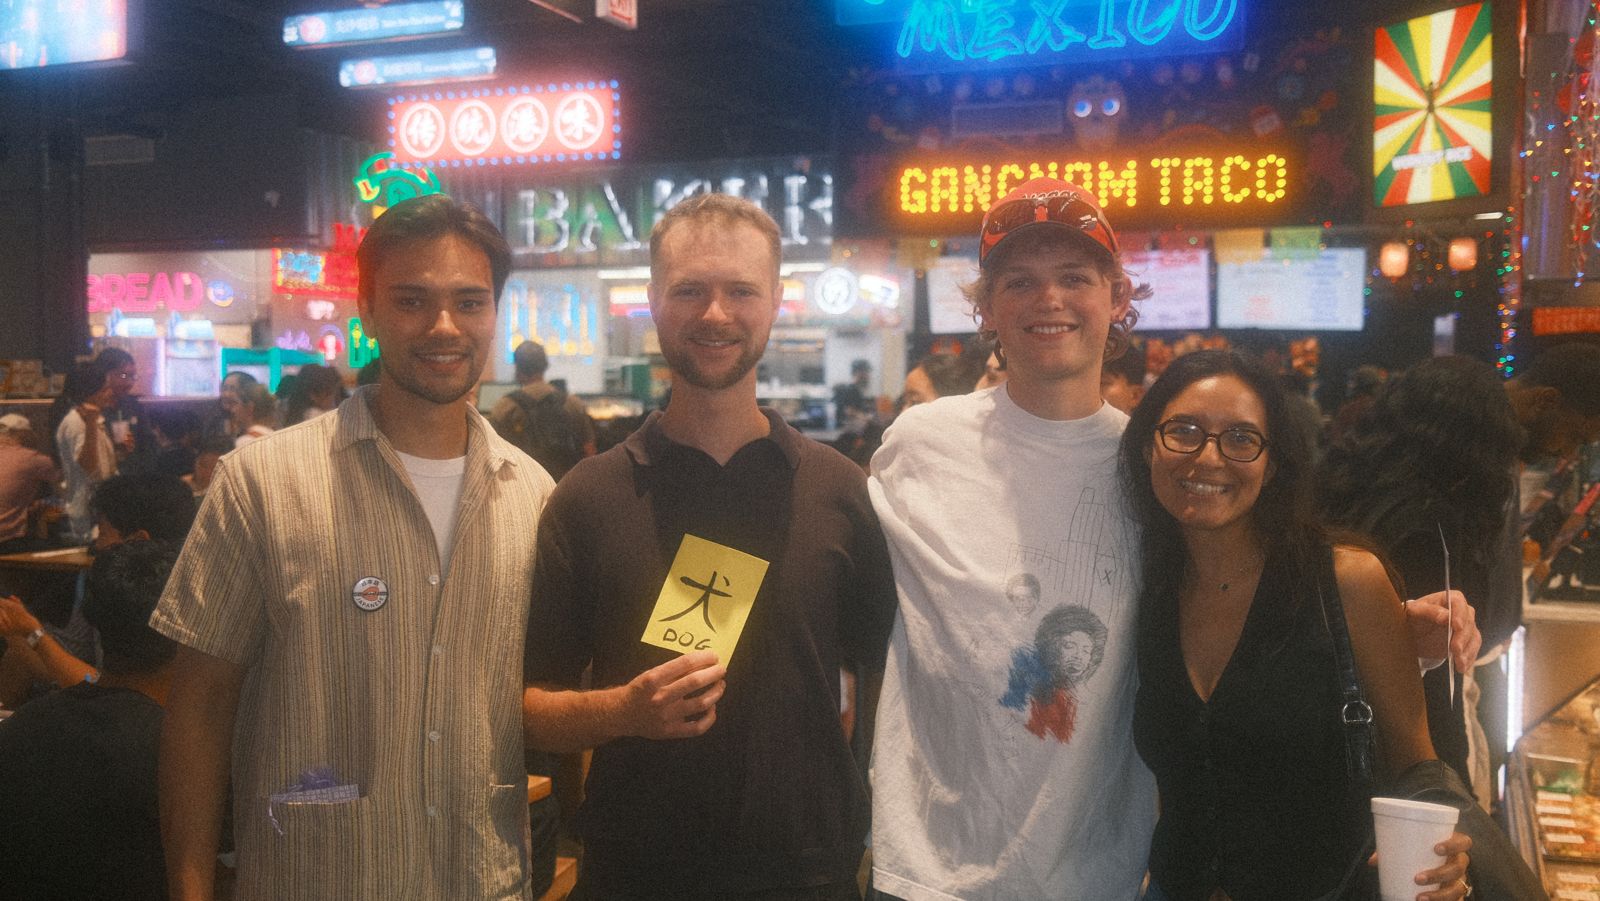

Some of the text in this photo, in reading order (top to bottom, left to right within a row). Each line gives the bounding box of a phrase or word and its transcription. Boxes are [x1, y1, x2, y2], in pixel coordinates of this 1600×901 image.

[403, 96, 602, 151] 传统港味
[1151, 154, 1287, 205] TACO
[87, 271, 204, 313] BREAD
[658, 571, 732, 634] 犬
[662, 628, 713, 651] DOG
